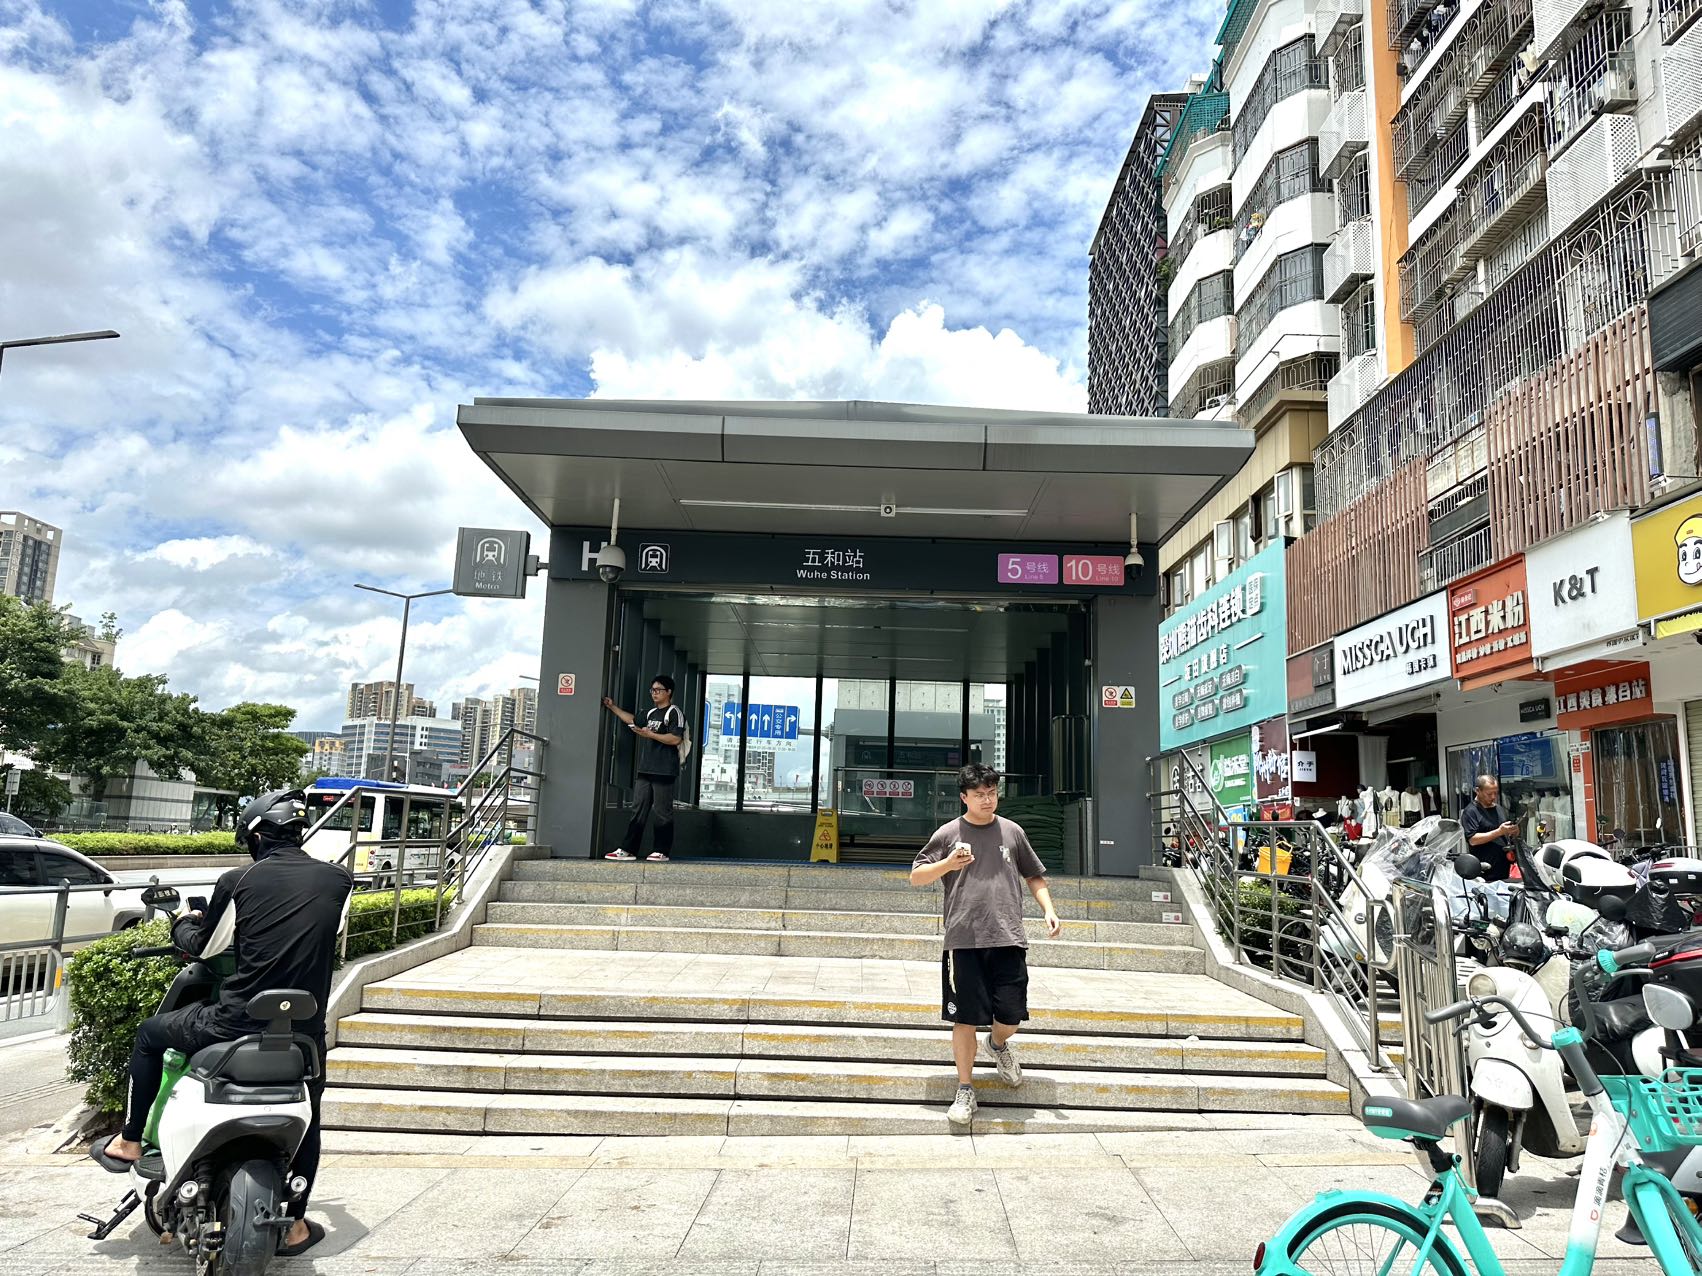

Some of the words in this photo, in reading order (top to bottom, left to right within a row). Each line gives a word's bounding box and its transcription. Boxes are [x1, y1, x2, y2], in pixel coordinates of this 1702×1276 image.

[581, 540, 608, 571] H
[803, 548, 865, 568] 五和站
[474, 570, 503, 582] 地铁
[796, 569, 828, 580] Wuhe
[830, 570, 871, 581] Station
[1007, 557, 1022, 579] 5
[1025, 561, 1049, 574] 号线
[1066, 559, 1093, 581] 10
[1096, 563, 1120, 575] 号线
[1552, 566, 1601, 607] K&T
[1454, 590, 1524, 648] 江西米粉
[775, 713, 783, 736] 公交专用
[1593, 1167, 1608, 1206] 滴滴青桔
